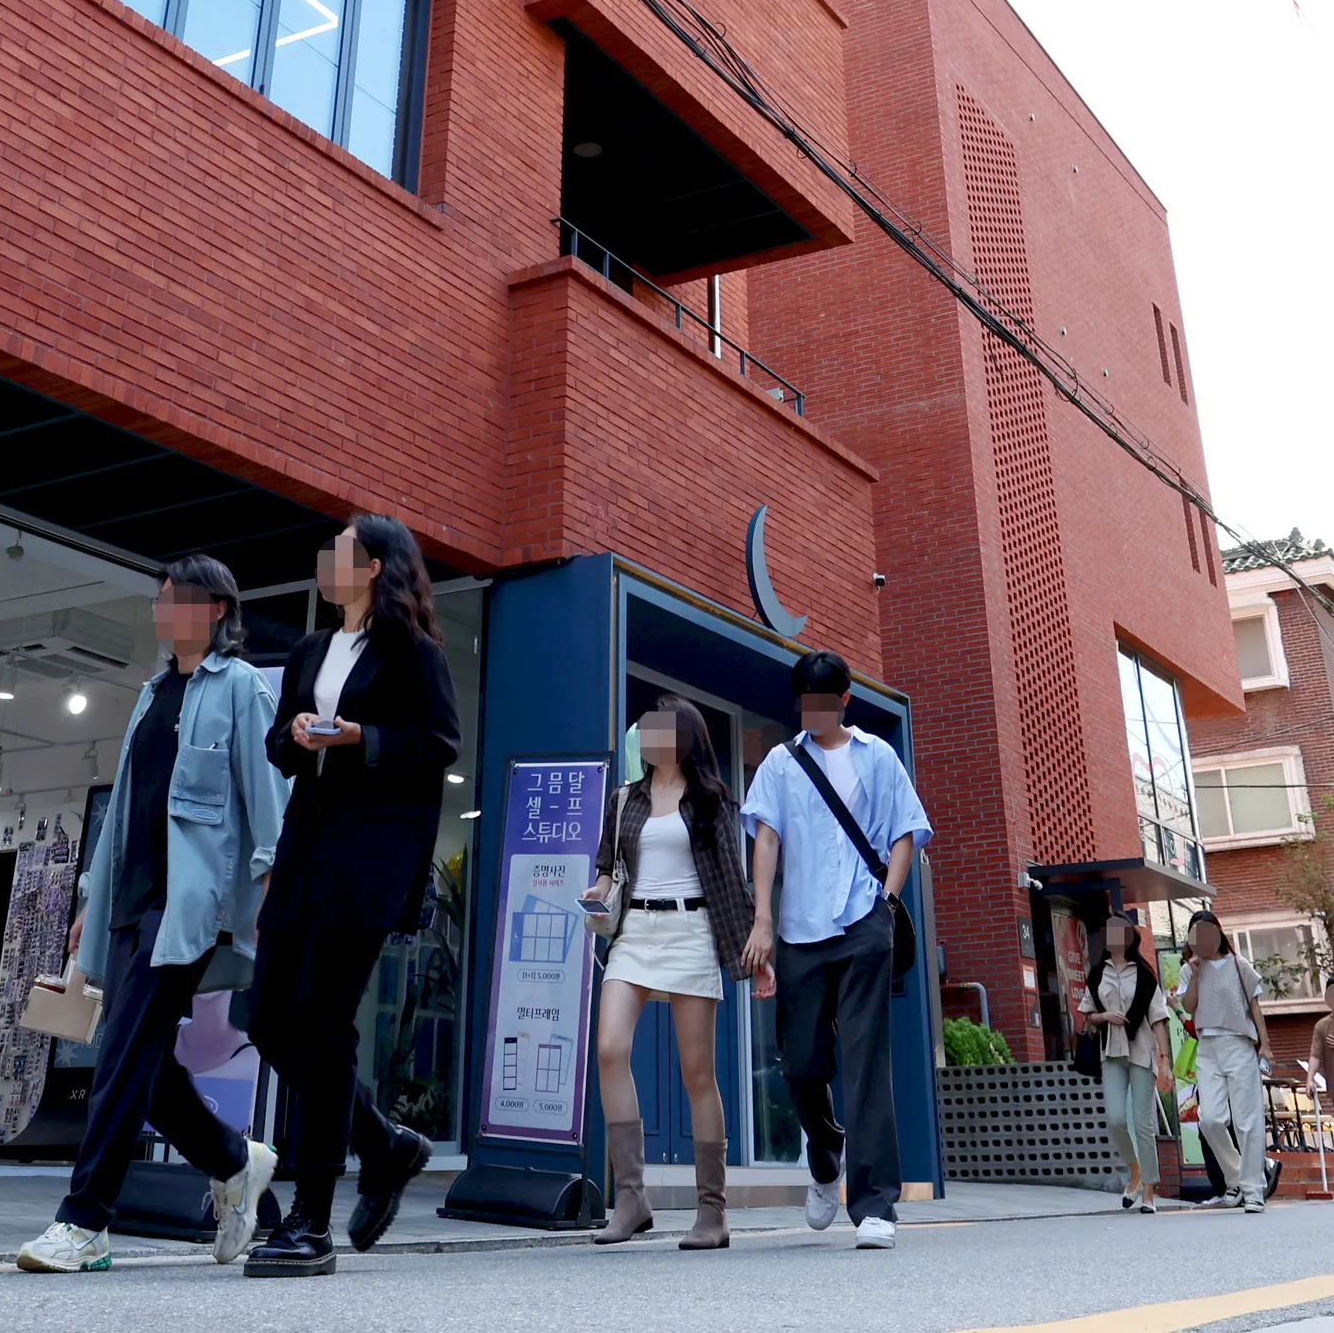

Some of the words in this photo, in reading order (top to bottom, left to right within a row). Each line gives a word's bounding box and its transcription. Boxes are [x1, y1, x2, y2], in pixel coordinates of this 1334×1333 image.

[527, 771, 585, 795] 그믐달
[521, 821, 583, 844] 스튜디오
[532, 865, 566, 878] 증명사진
[1021, 924, 1030, 939] 34
[517, 1006, 560, 1022] 멀티프레임
[500, 1100, 524, 1109] 4,000원
[539, 1102, 563, 1113] 5,000원
